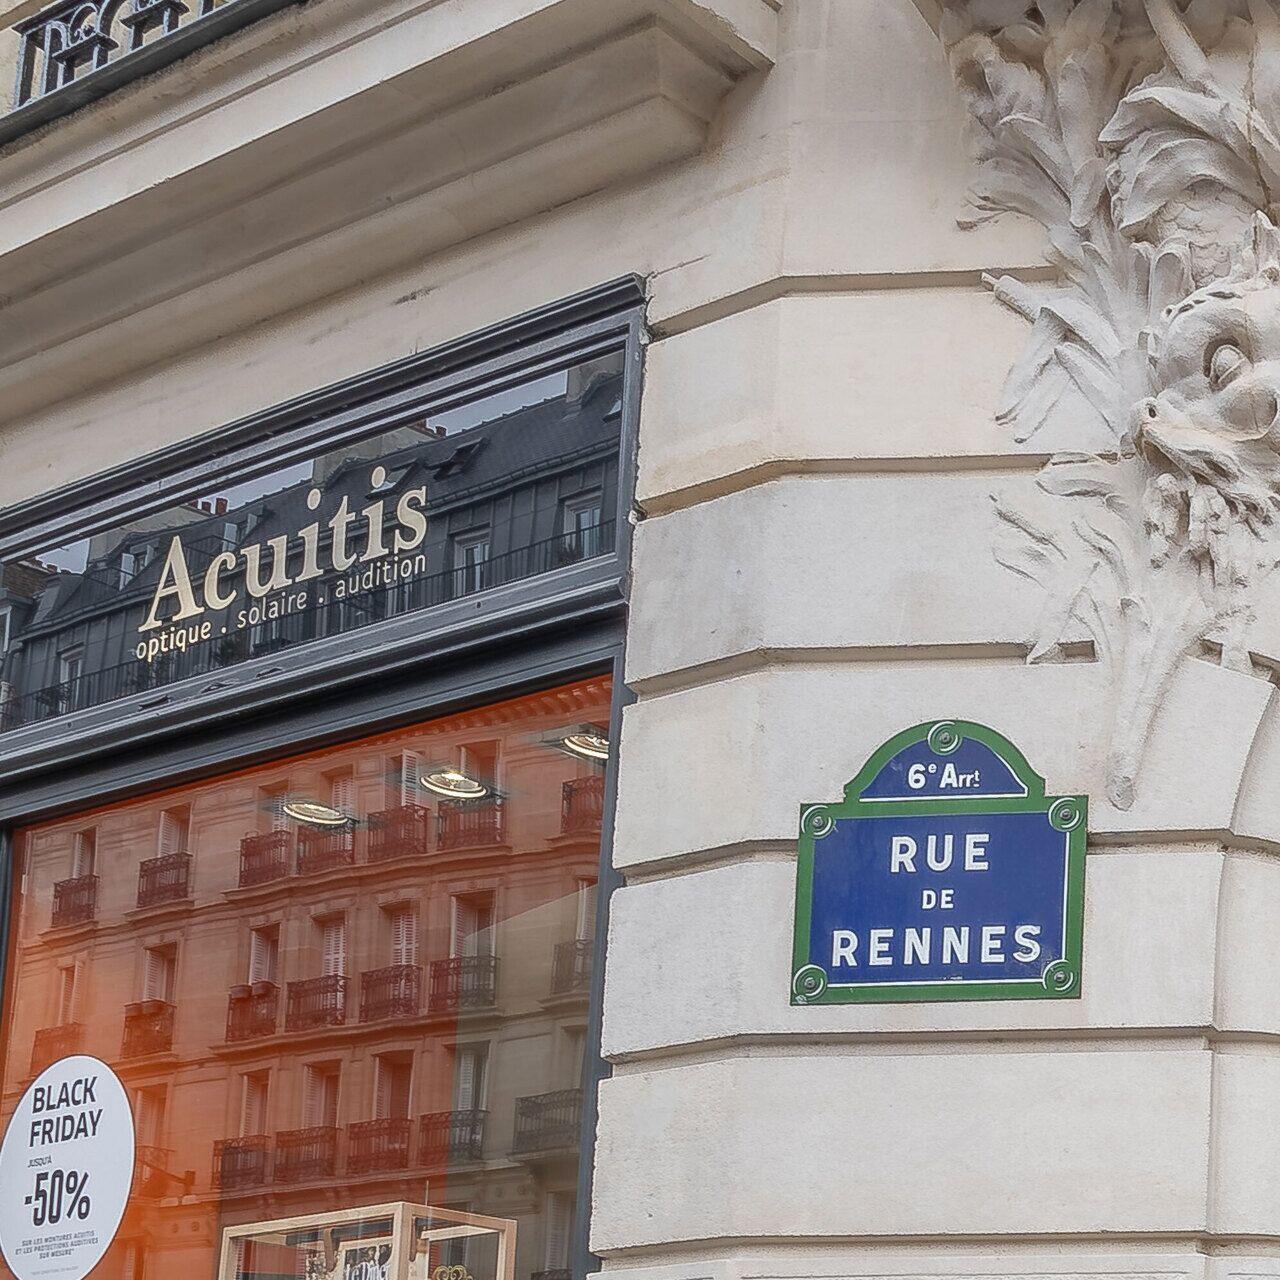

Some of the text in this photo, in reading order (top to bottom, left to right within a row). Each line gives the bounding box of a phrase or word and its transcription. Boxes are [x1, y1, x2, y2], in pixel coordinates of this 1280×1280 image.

[138, 466, 428, 632] Acuitis
[136, 554, 426, 662] optique solaire audition
[890, 833, 991, 873] RUE
[922, 888, 955, 910] DE
[832, 924, 1043, 967] RENNES
[32, 1076, 98, 1114] BLACK
[29, 1108, 103, 1147] FRIDAY
[24, 1169, 91, 1226] -50%
